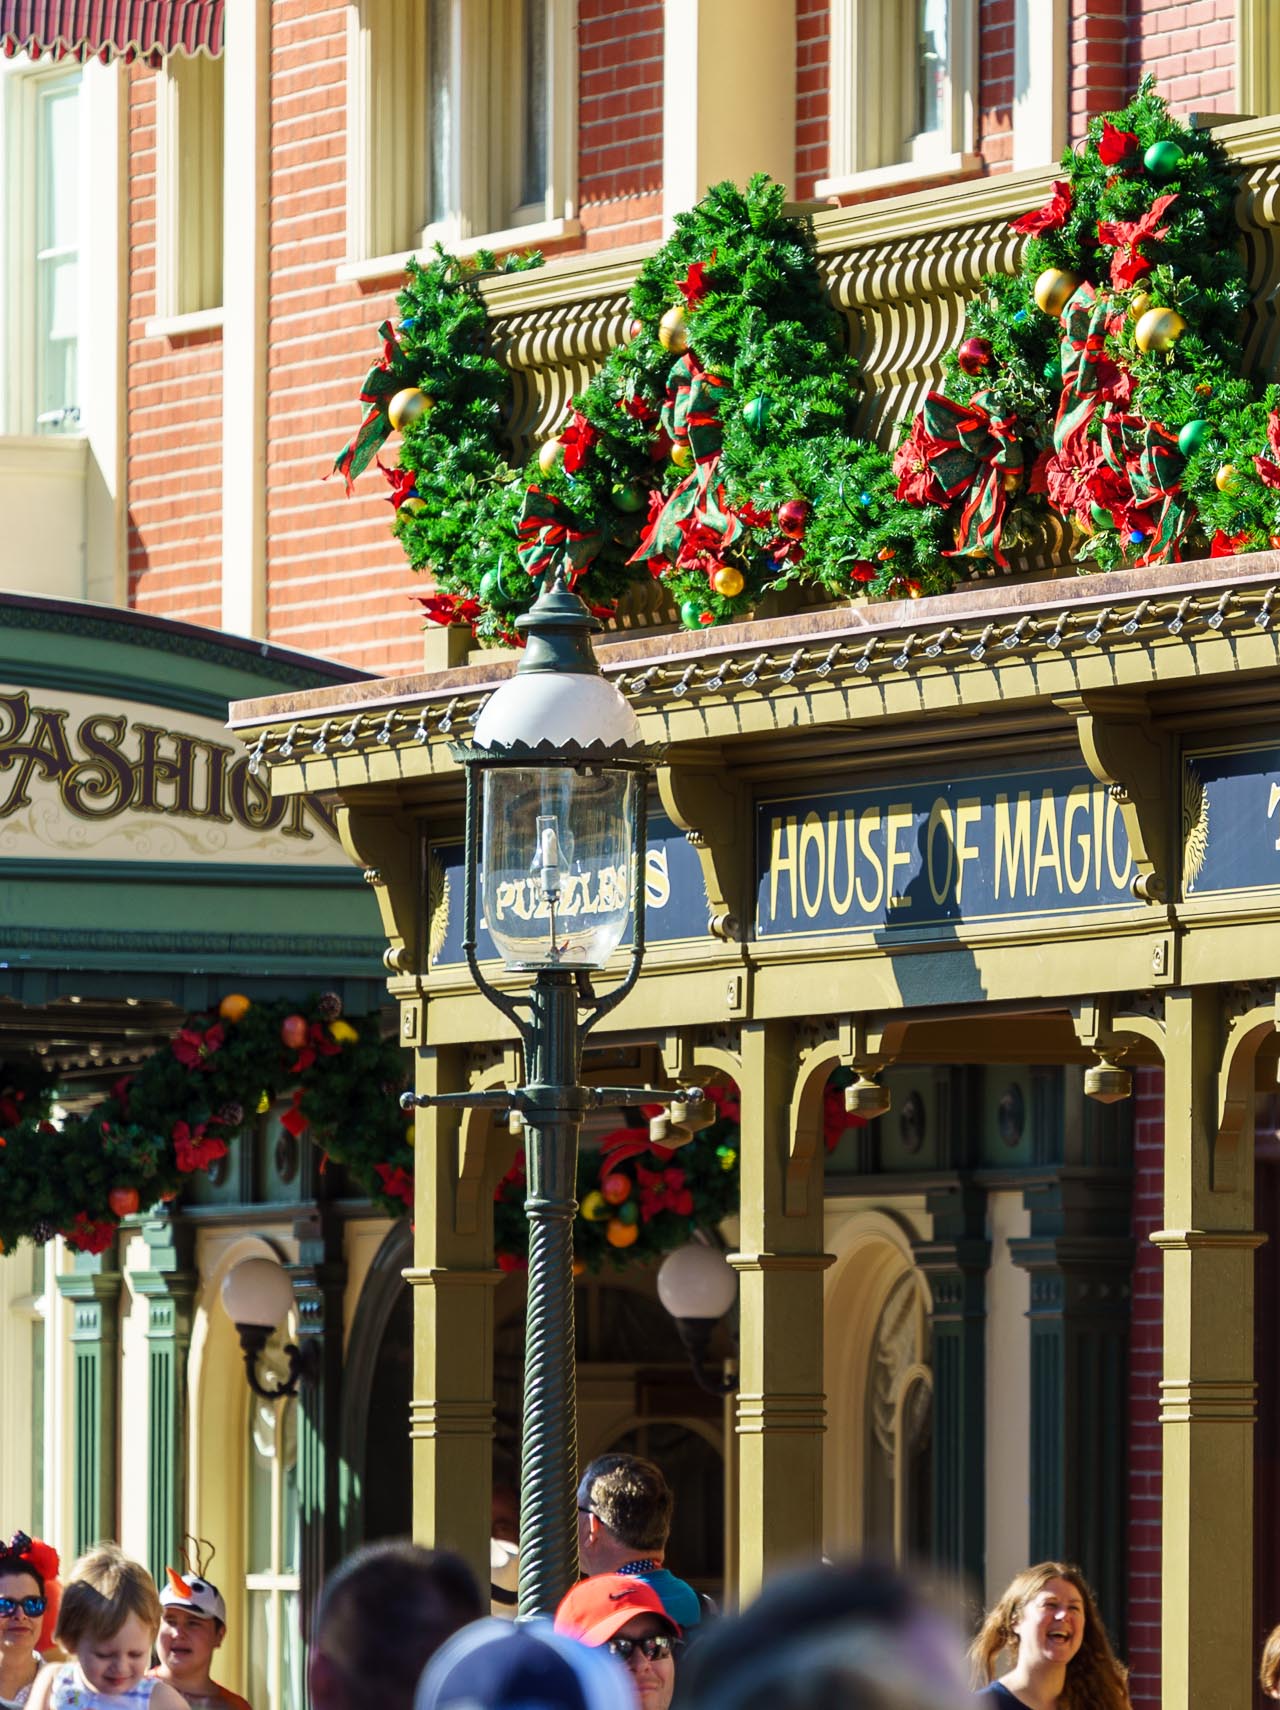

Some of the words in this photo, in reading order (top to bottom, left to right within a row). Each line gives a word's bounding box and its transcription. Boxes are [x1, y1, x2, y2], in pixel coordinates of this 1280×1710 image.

[769, 802, 913, 921] HOUSE
[927, 796, 982, 905] OF
[994, 784, 1134, 900] MAGIC
